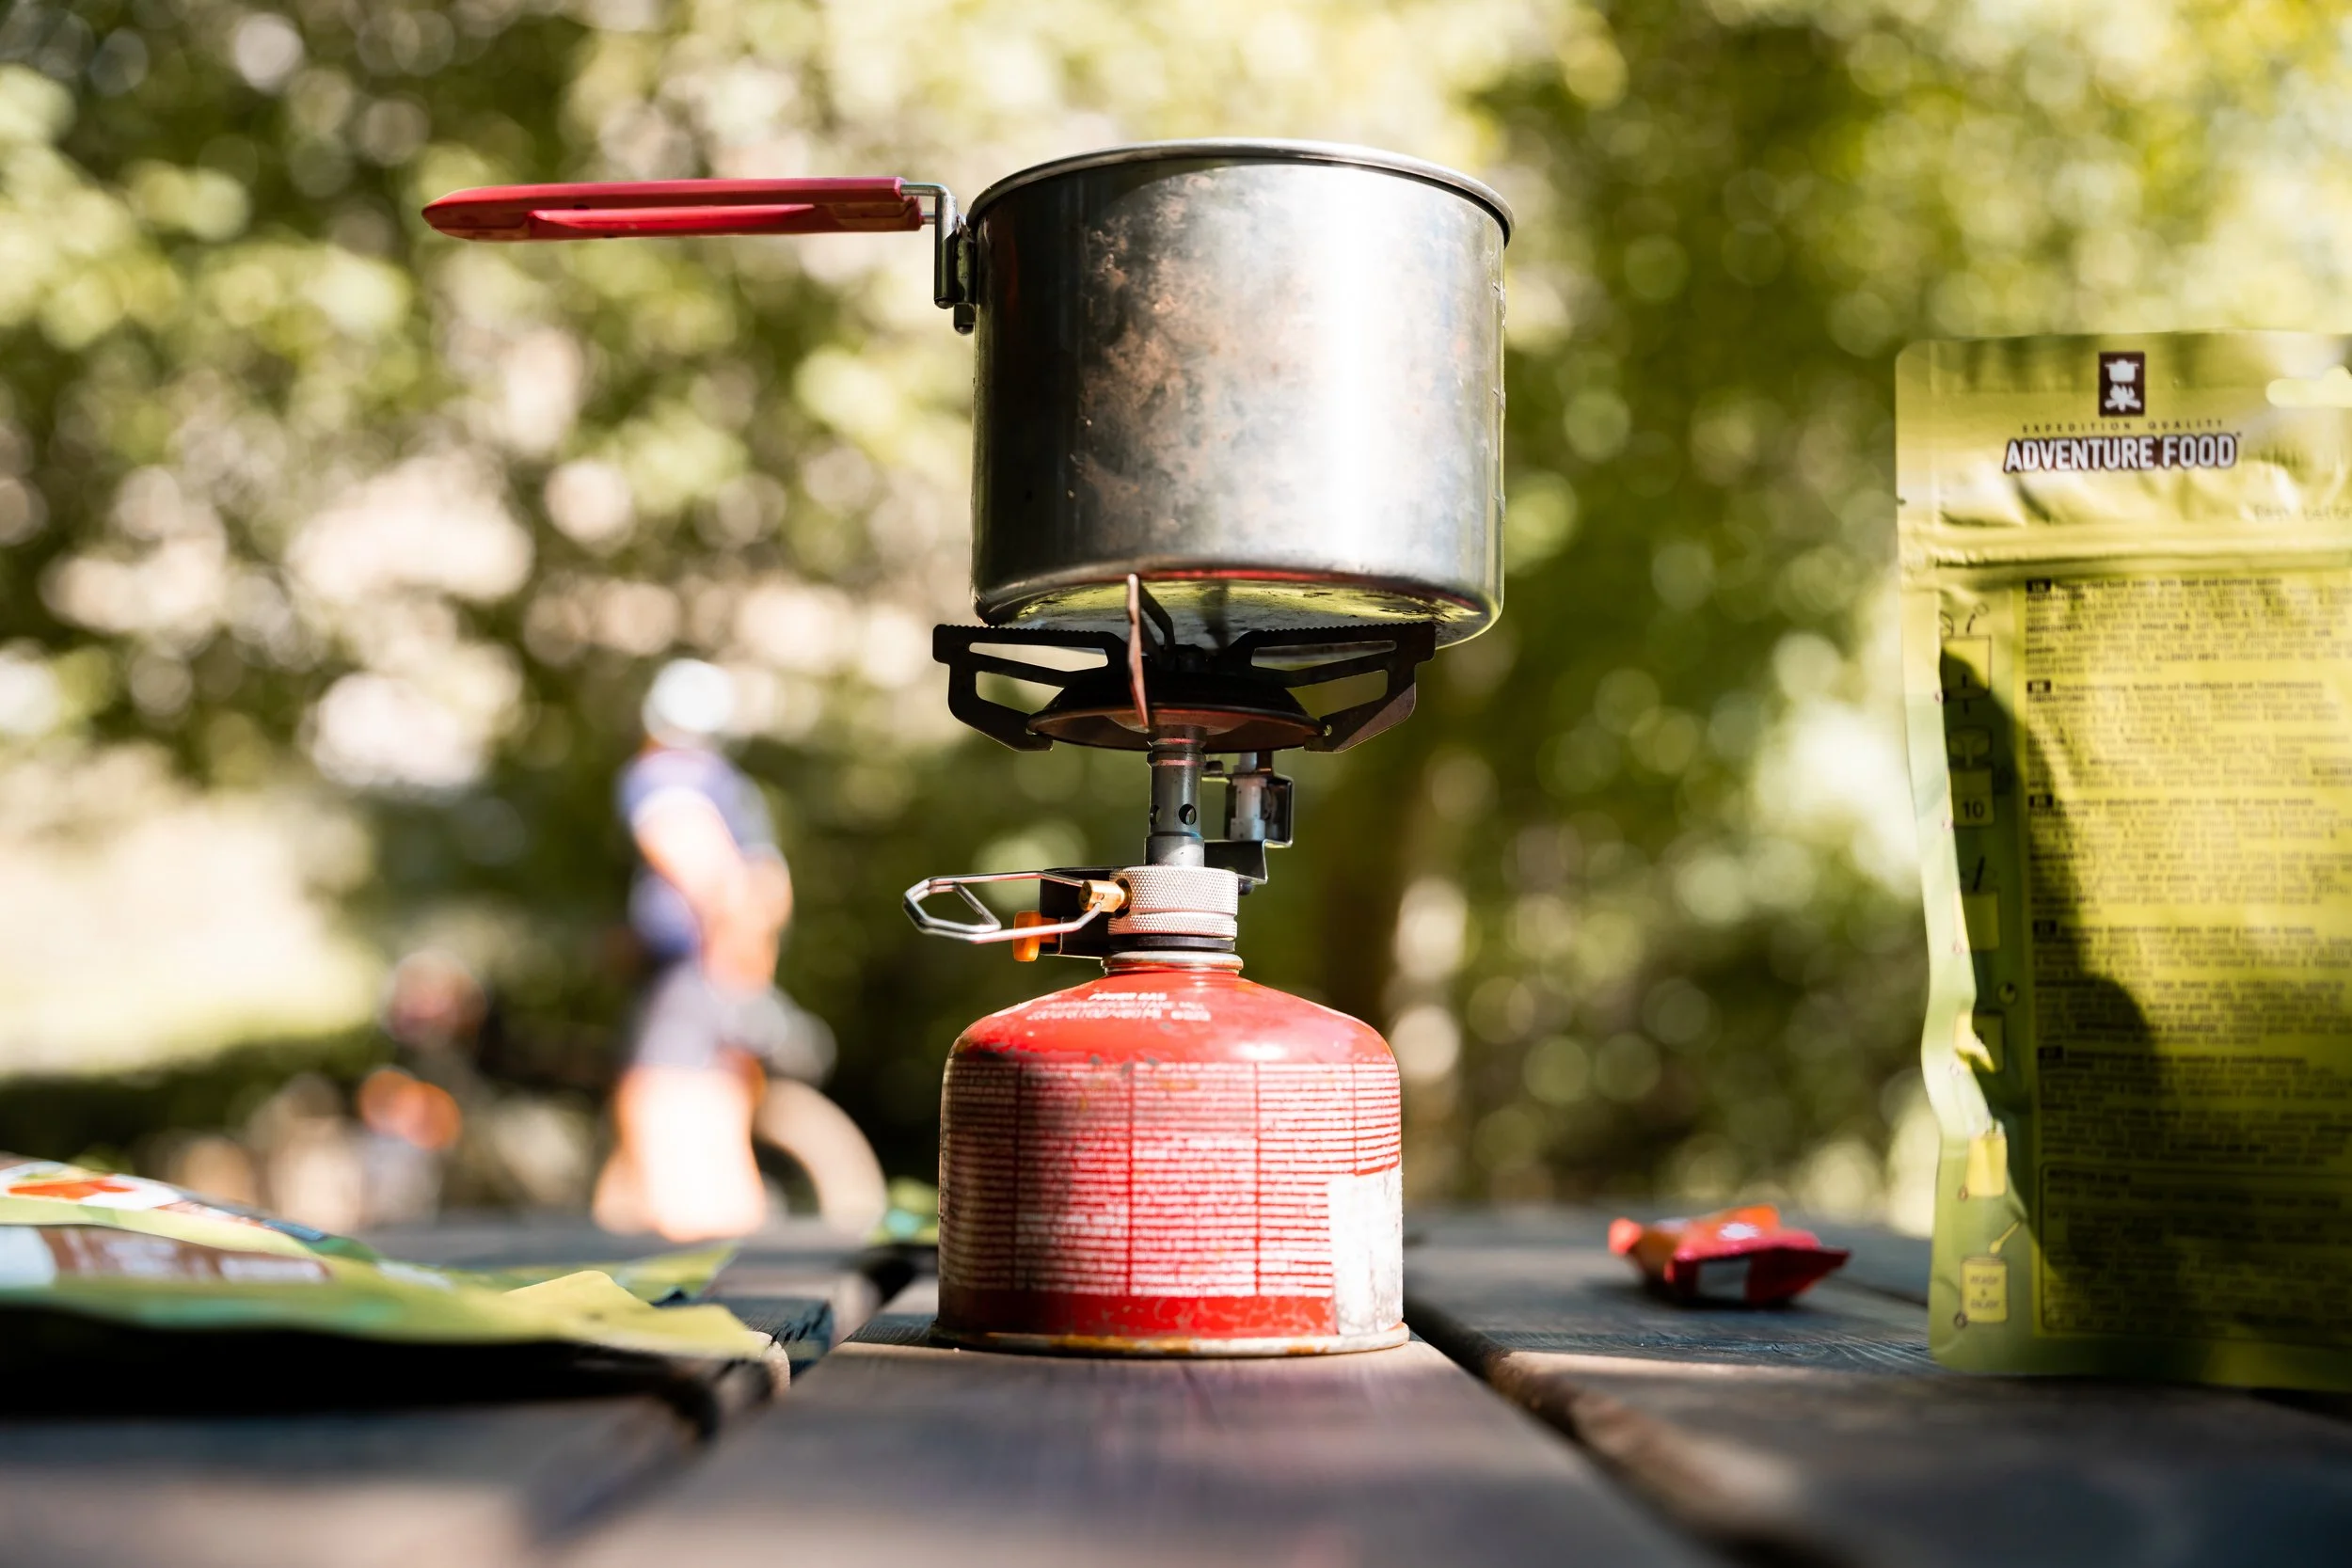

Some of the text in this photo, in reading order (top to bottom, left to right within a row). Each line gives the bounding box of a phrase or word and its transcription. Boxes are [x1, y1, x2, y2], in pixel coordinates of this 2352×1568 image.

[2022, 420, 2224, 433] EXPEDITION QUALITY
[2005, 436, 2236, 473] ADVENTURE FOOD
[1962, 800, 1985, 819] 10
